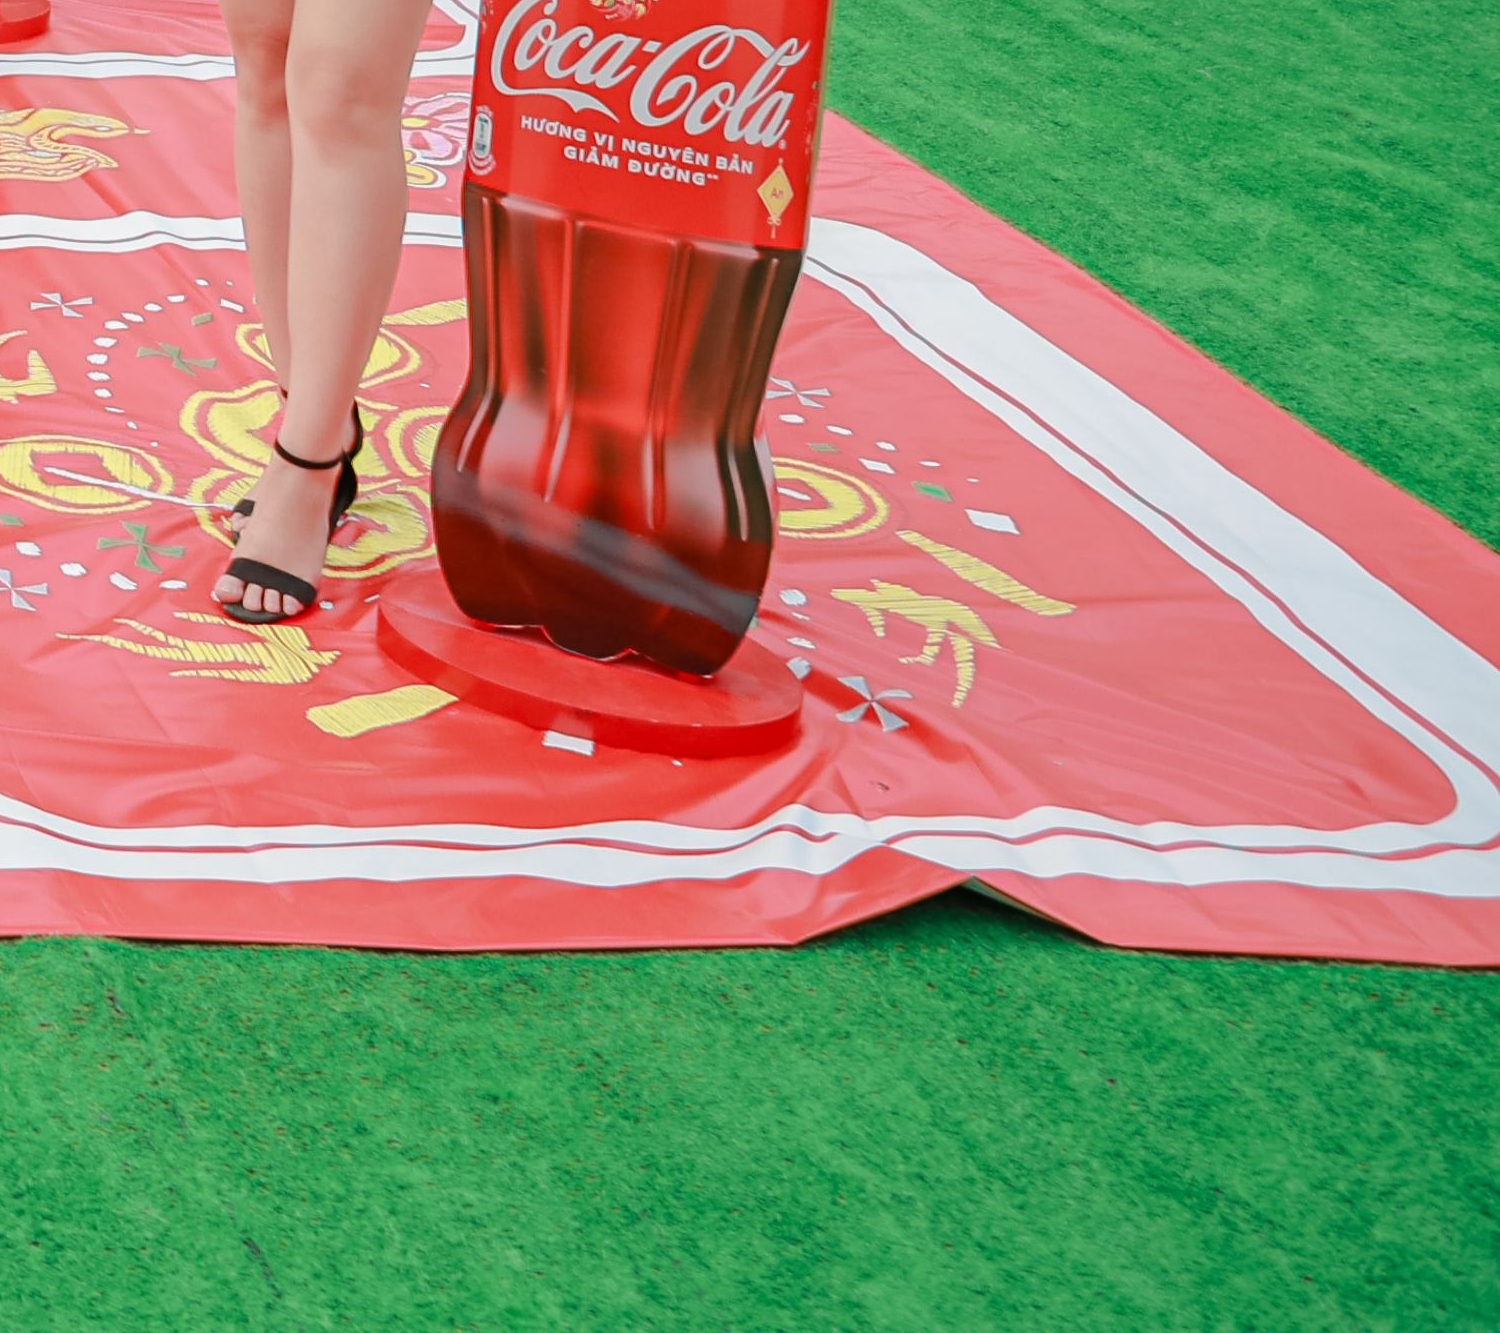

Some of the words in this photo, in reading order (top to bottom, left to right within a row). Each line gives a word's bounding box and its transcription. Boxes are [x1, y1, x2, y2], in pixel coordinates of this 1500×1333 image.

[520, 115, 588, 143] HƯƠNG
[594, 131, 616, 153] VỊ
[621, 136, 710, 167] NGUYÊN
[715, 152, 754, 175] BẢN
[563, 145, 620, 169] GIẢM
